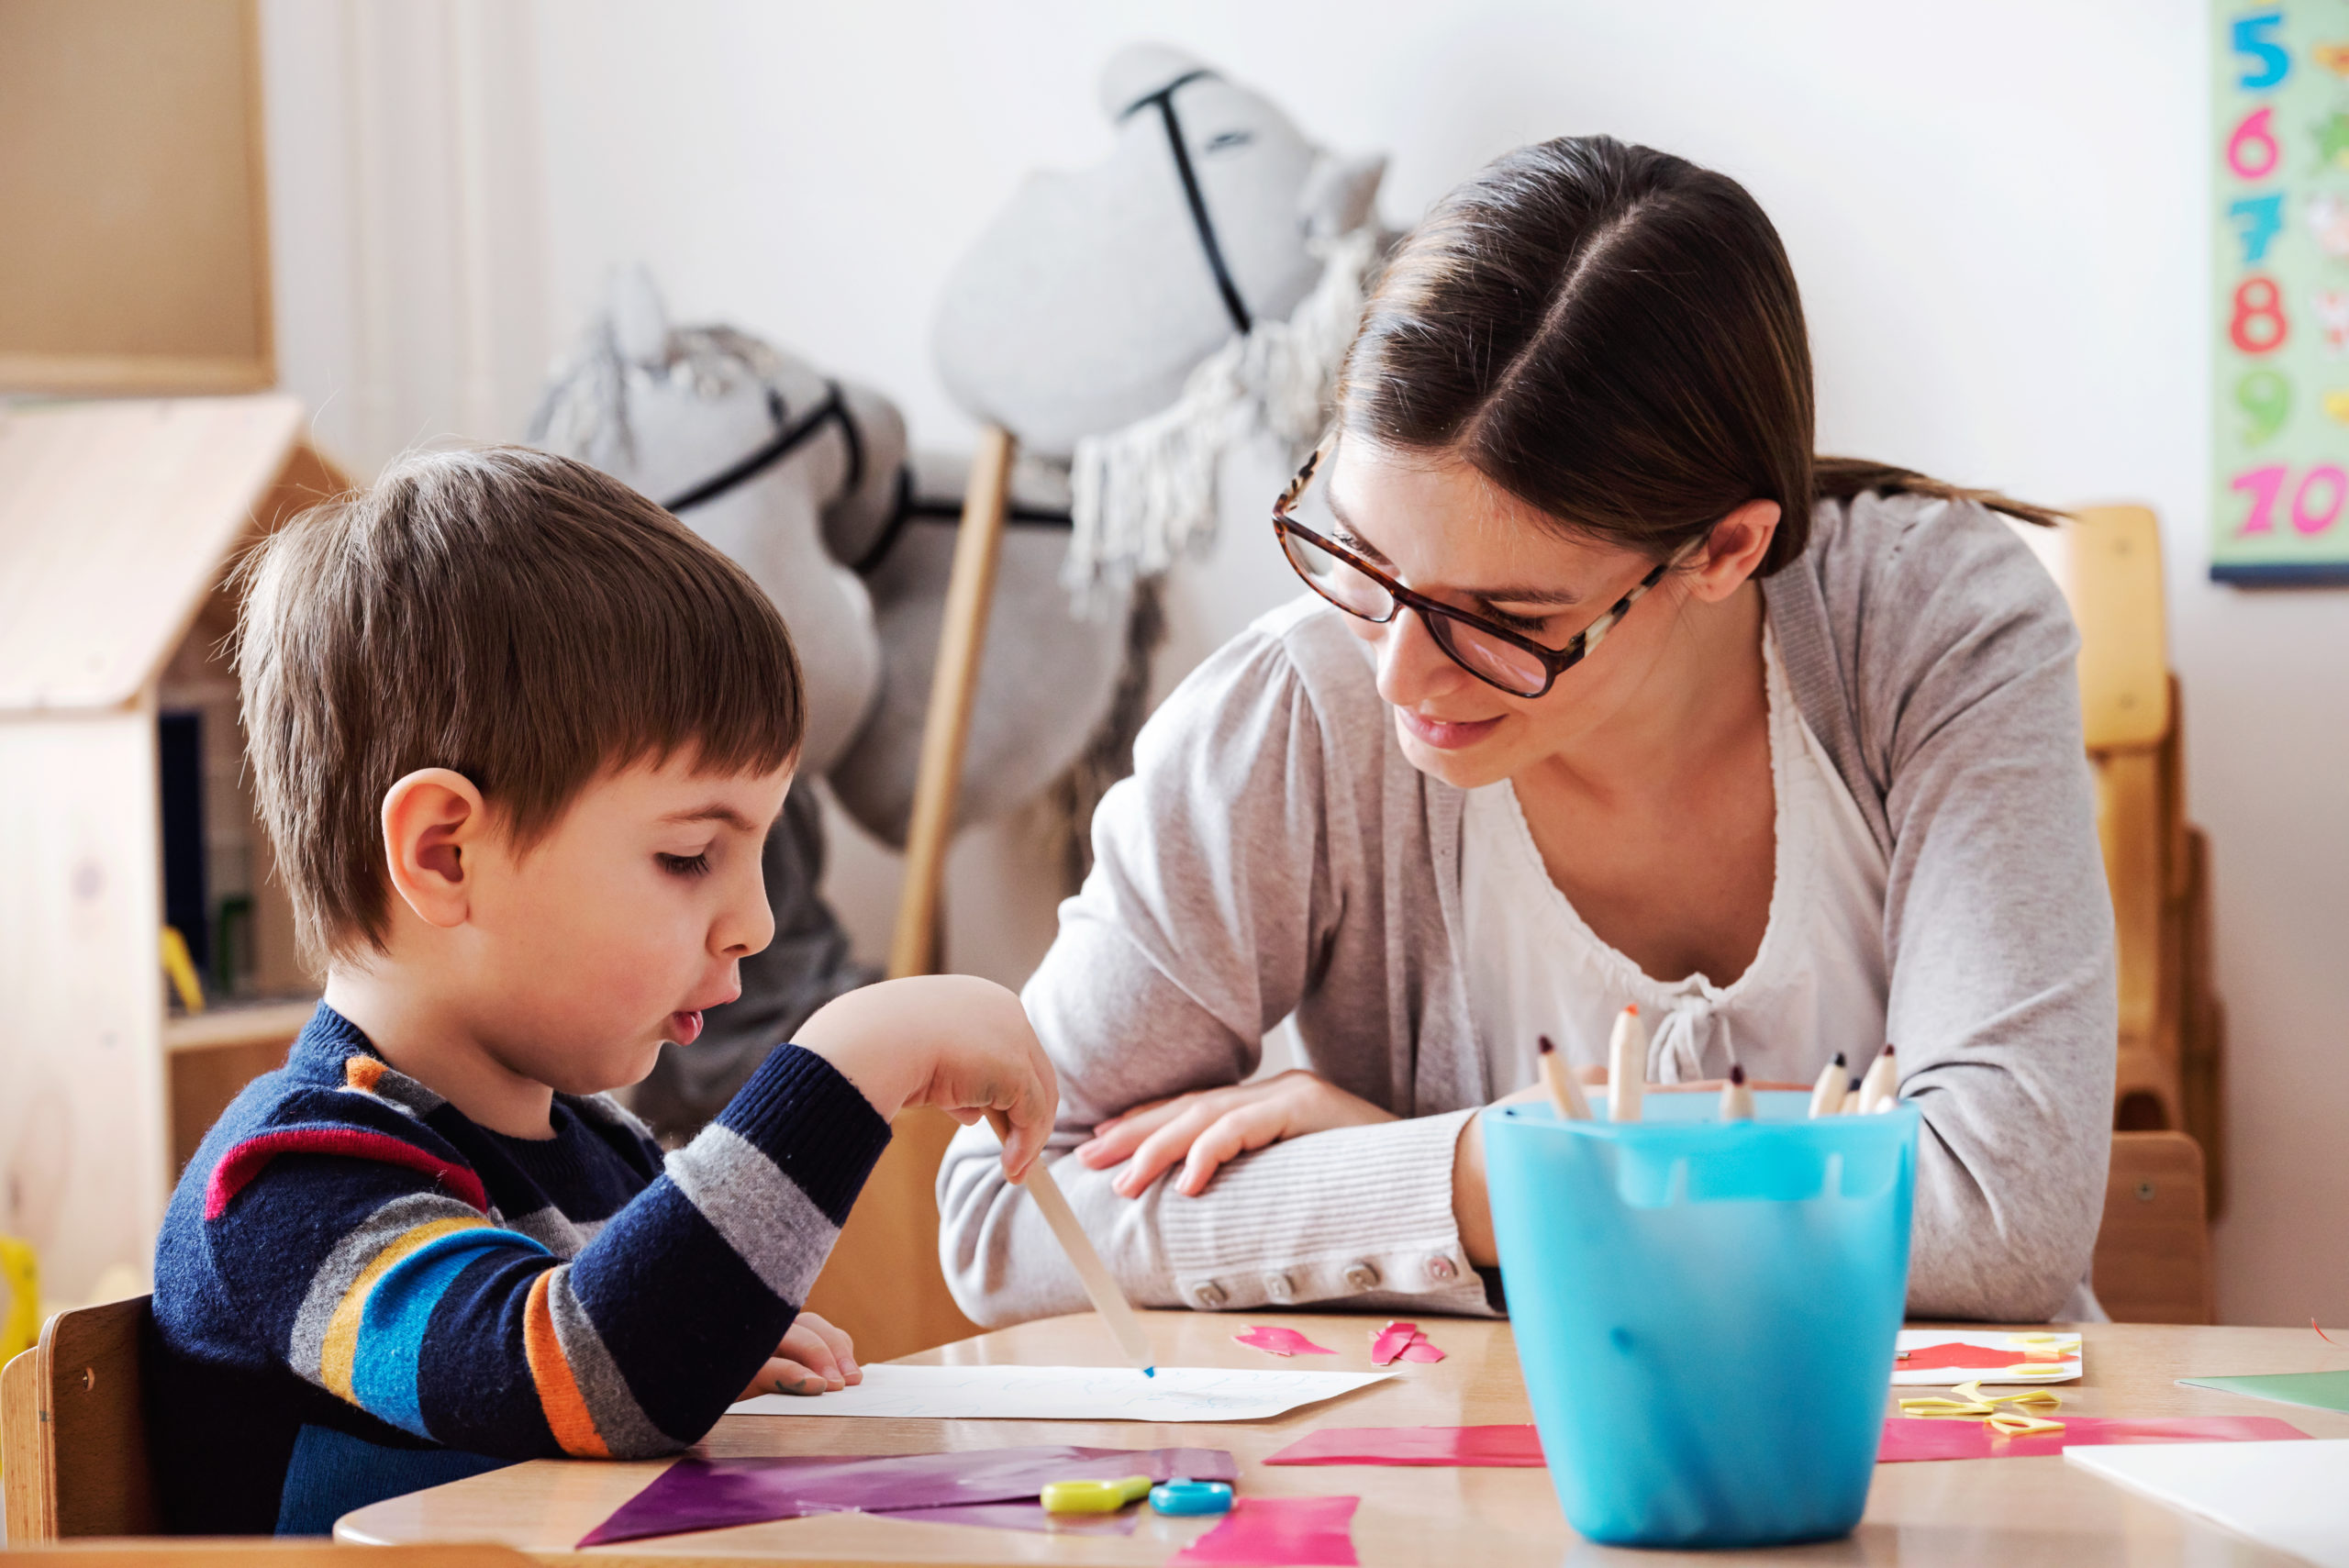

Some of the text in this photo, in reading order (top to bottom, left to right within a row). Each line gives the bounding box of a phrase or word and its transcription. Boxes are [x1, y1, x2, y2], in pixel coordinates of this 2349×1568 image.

[2231, 14, 2290, 89] 5
[2226, 106, 2279, 180] 6
[2228, 192, 2284, 264] 7
[2229, 276, 2288, 355] 8
[2234, 369, 2290, 447] 9
[2230, 465, 2349, 538] 10
